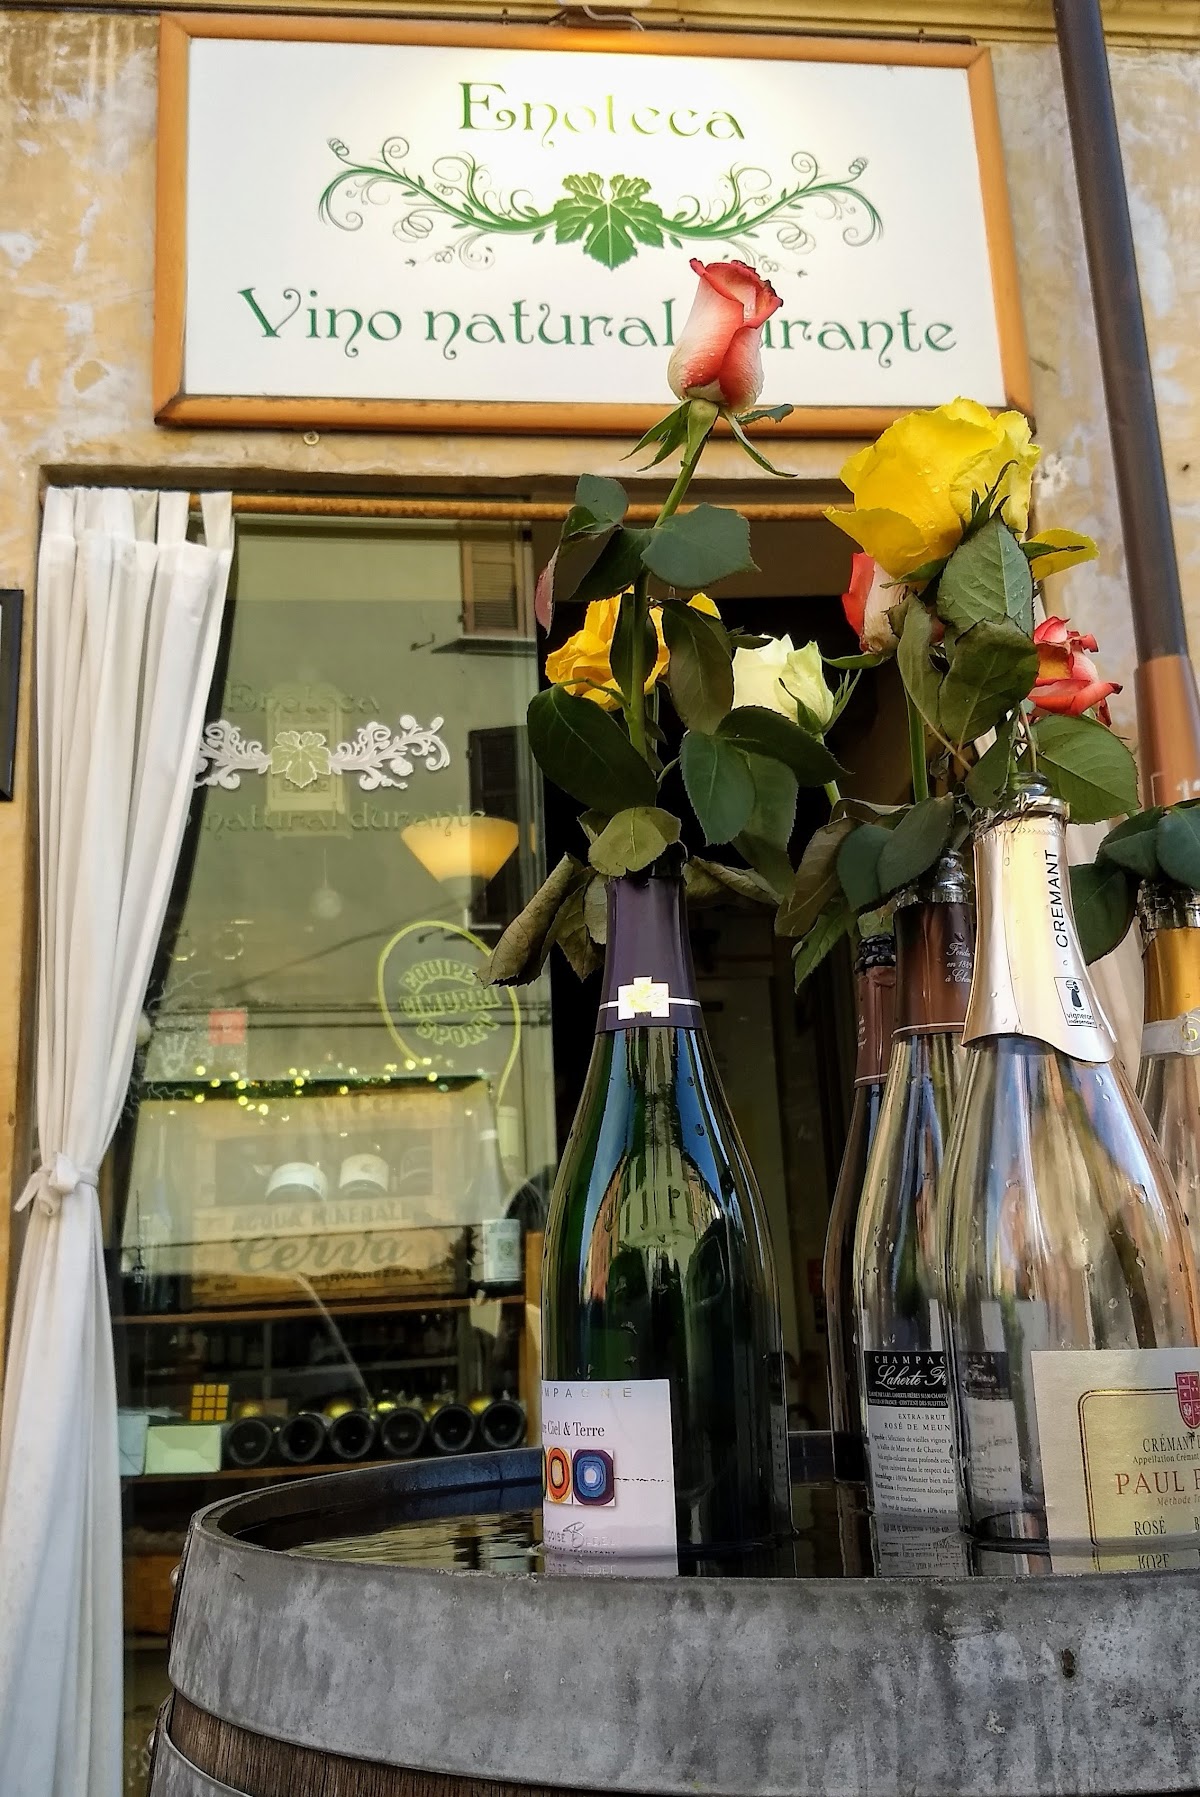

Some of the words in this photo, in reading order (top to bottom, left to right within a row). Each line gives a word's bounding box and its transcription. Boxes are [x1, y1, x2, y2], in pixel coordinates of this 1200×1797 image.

[458, 81, 746, 148] Enoteca
[237, 286, 403, 358] Vino
[422, 298, 677, 360] natural
[762, 308, 957, 368] rante
[1044, 849, 1069, 948] CREMANT
[416, 1011, 500, 1048] SPORT
[875, 1365, 927, 1390] Laherte
[884, 1422, 902, 1430] ROSÉ
[898, 1413, 946, 1421] EXTRA-BRUT
[547, 1420, 561, 1436] Ciel
[563, 1422, 571, 1436] &
[572, 1421, 605, 1437] Terre
[1142, 1433, 1195, 1452] CRÉMANT
[1133, 1454, 1175, 1465] Appellation
[1115, 1470, 1185, 1495] PAUL
[1134, 1516, 1167, 1536] ROSÉ
